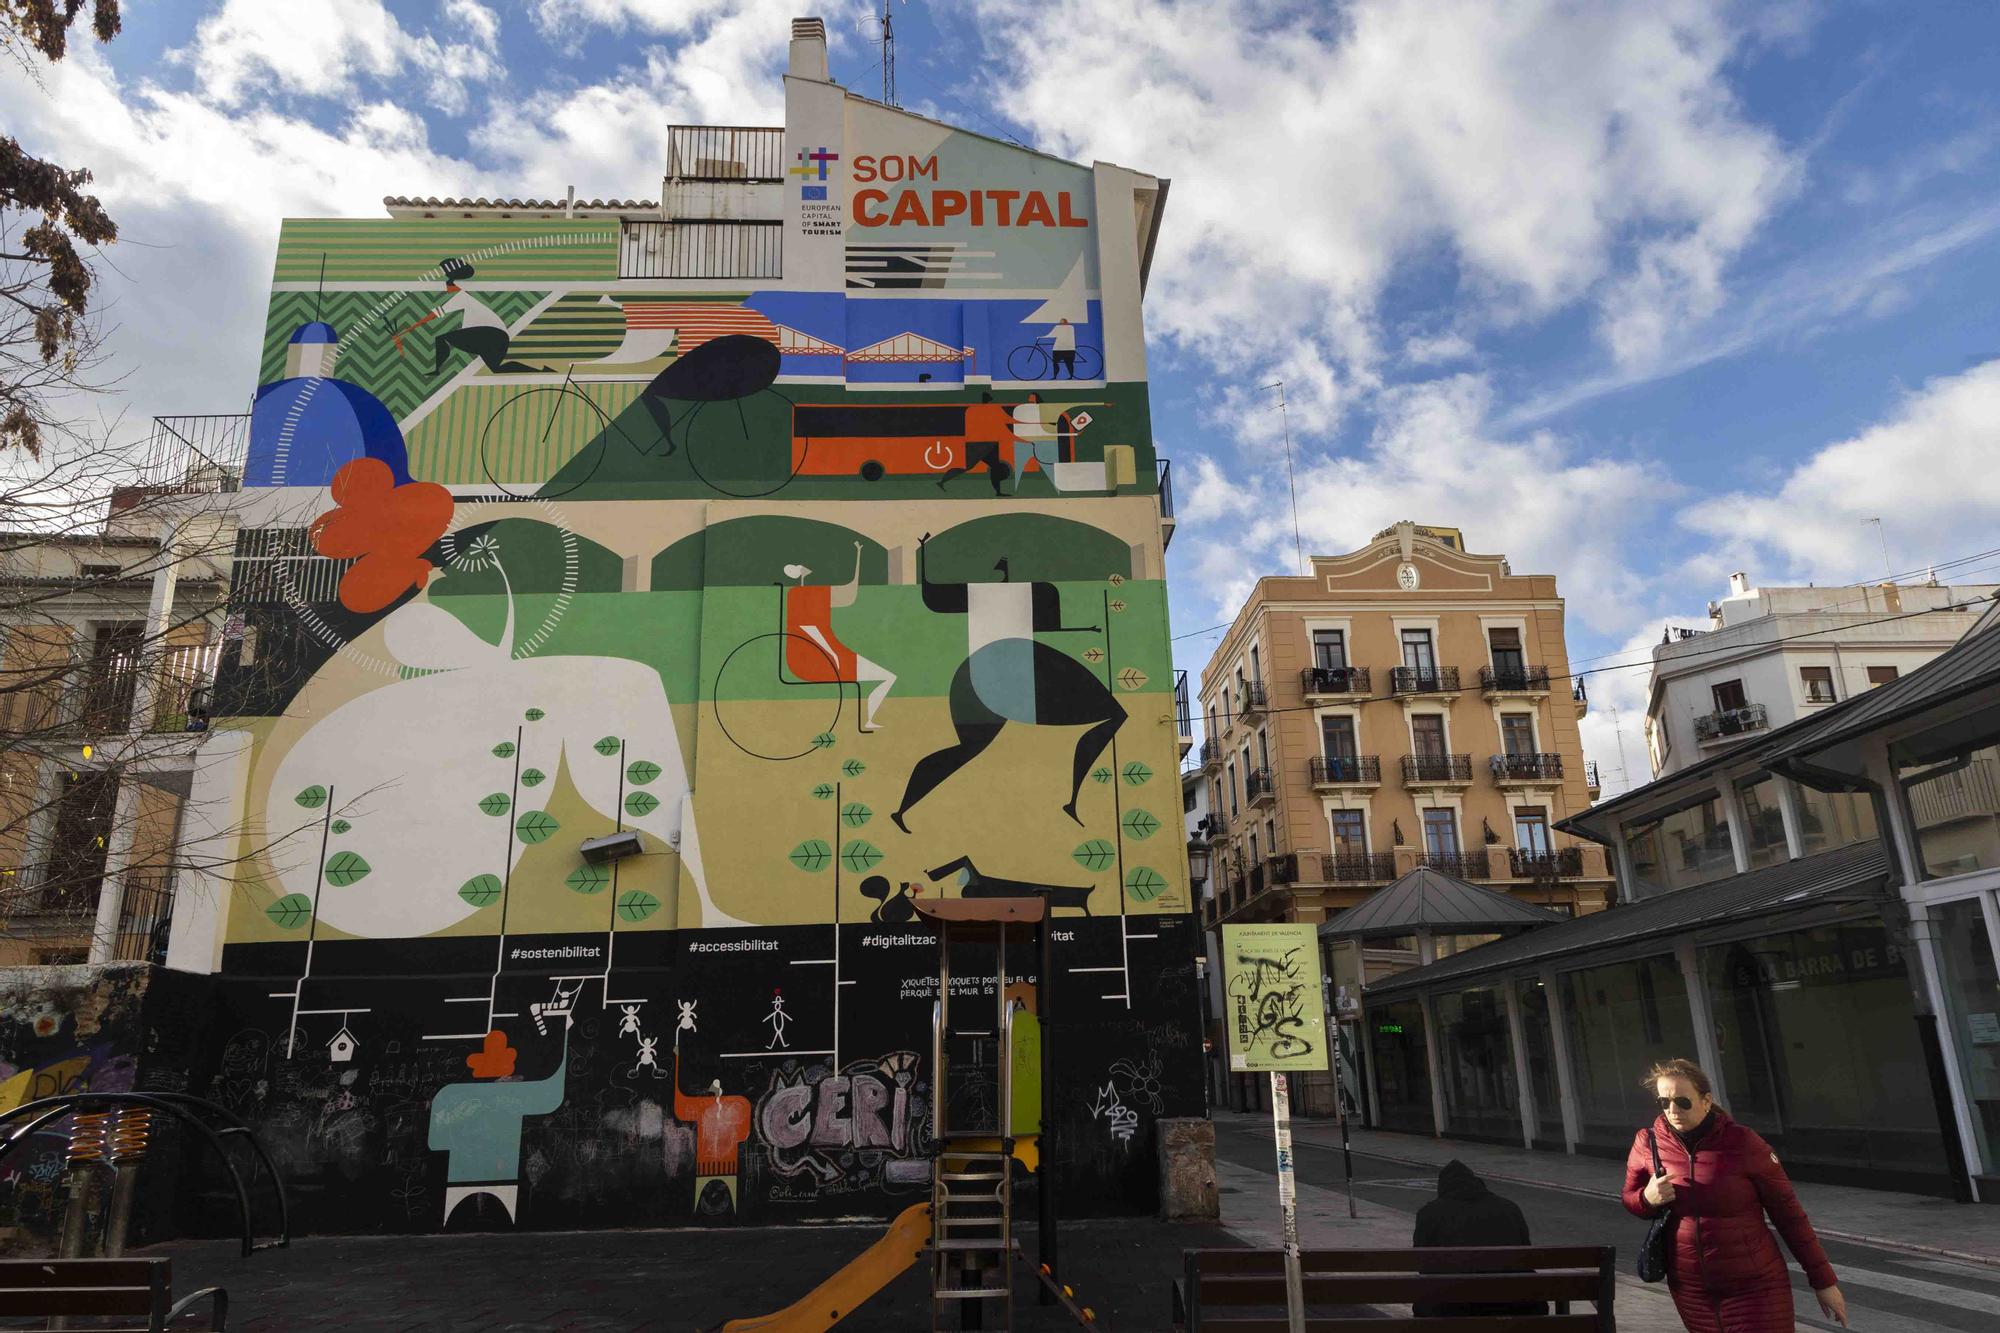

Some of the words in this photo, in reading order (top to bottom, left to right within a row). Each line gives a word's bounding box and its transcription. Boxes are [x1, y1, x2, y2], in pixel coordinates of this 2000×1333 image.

[852, 155, 938, 183] SOM
[801, 204, 841, 212] EUROPEAN
[852, 189, 1089, 228] CAPITAL
[801, 212, 833, 220] CAPITAL
[510, 946, 601, 960] #sostenibilitat
[688, 939, 779, 953] #accessibilitat
[1786, 952, 1845, 977] BARRA
[1852, 947, 1879, 969] DE
[901, 976, 940, 989] XIQUETES
[982, 976, 1014, 988] POREU
[959, 988, 979, 996] MUR
